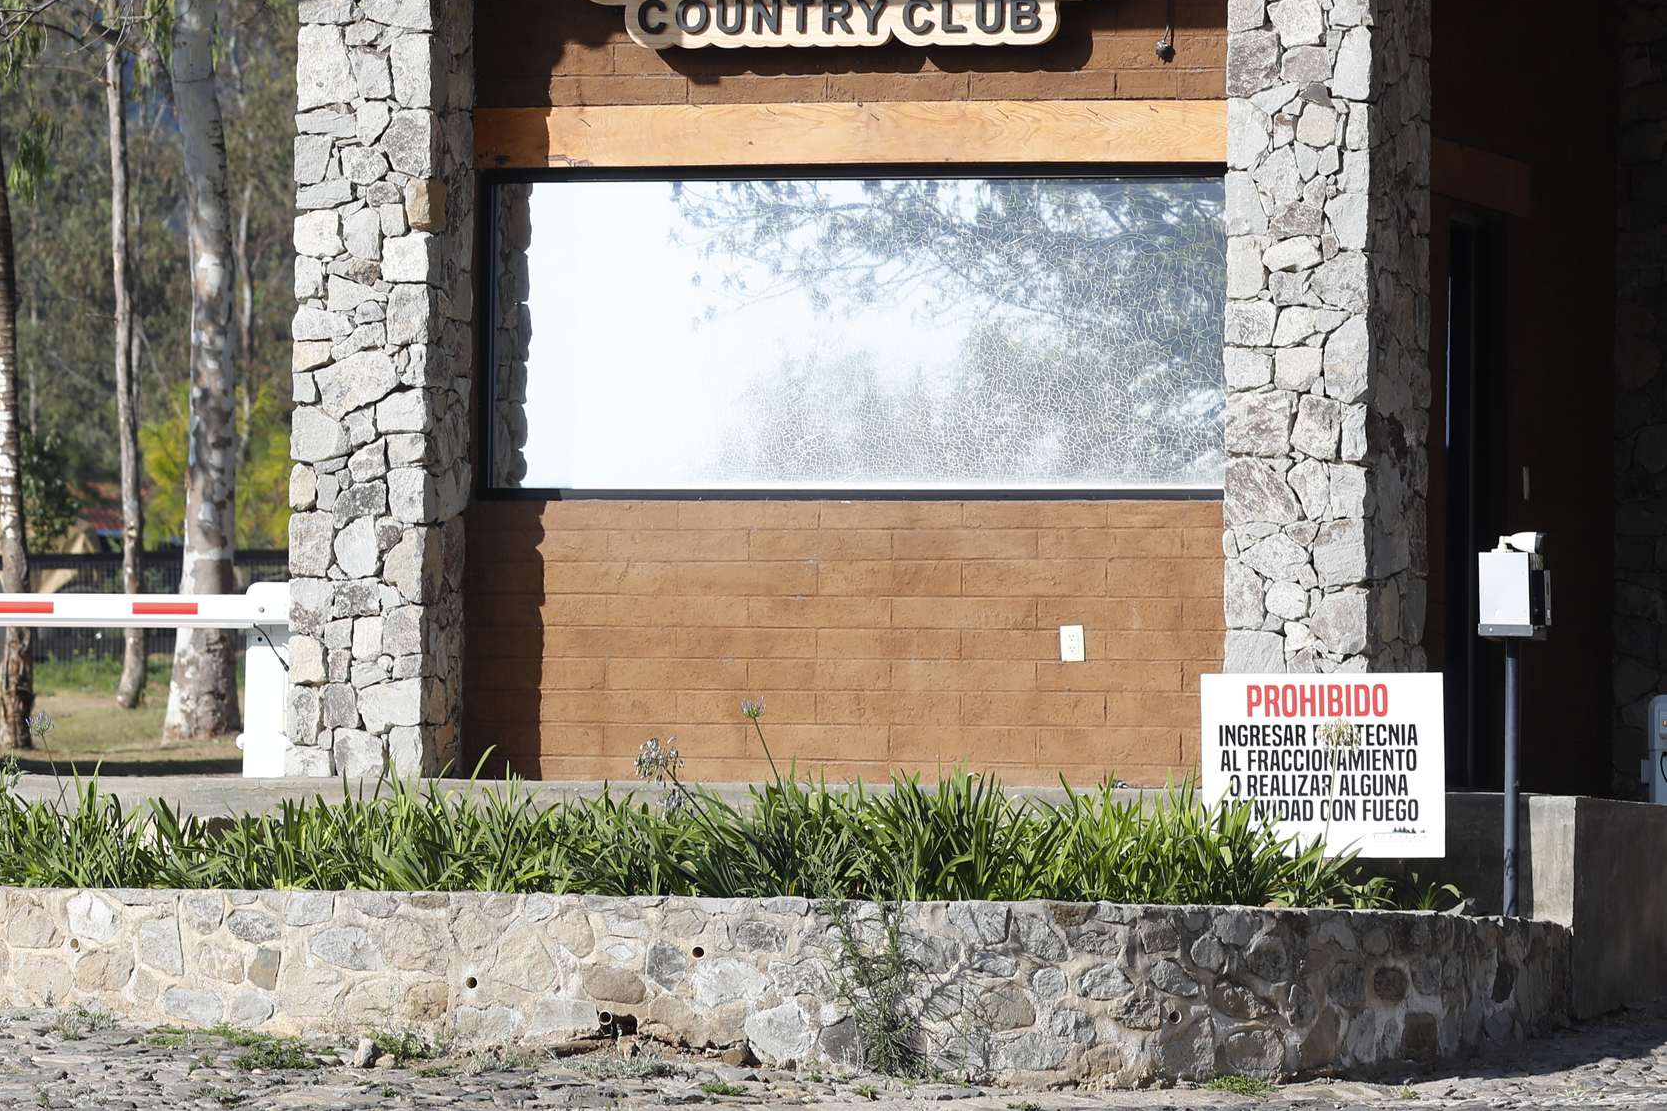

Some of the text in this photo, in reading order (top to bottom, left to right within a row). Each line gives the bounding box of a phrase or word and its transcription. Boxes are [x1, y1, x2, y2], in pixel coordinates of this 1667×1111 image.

[1247, 684, 1388, 717] PROHIBIDO
[1219, 724, 1306, 746] INGRESAR
[1221, 749, 1417, 771] AL FRACCIONAMIENTO
[1230, 774, 1408, 797] O REALIZAR ALGUNA
[1320, 799, 1355, 821] CON
[1363, 799, 1419, 821] FUEGO
